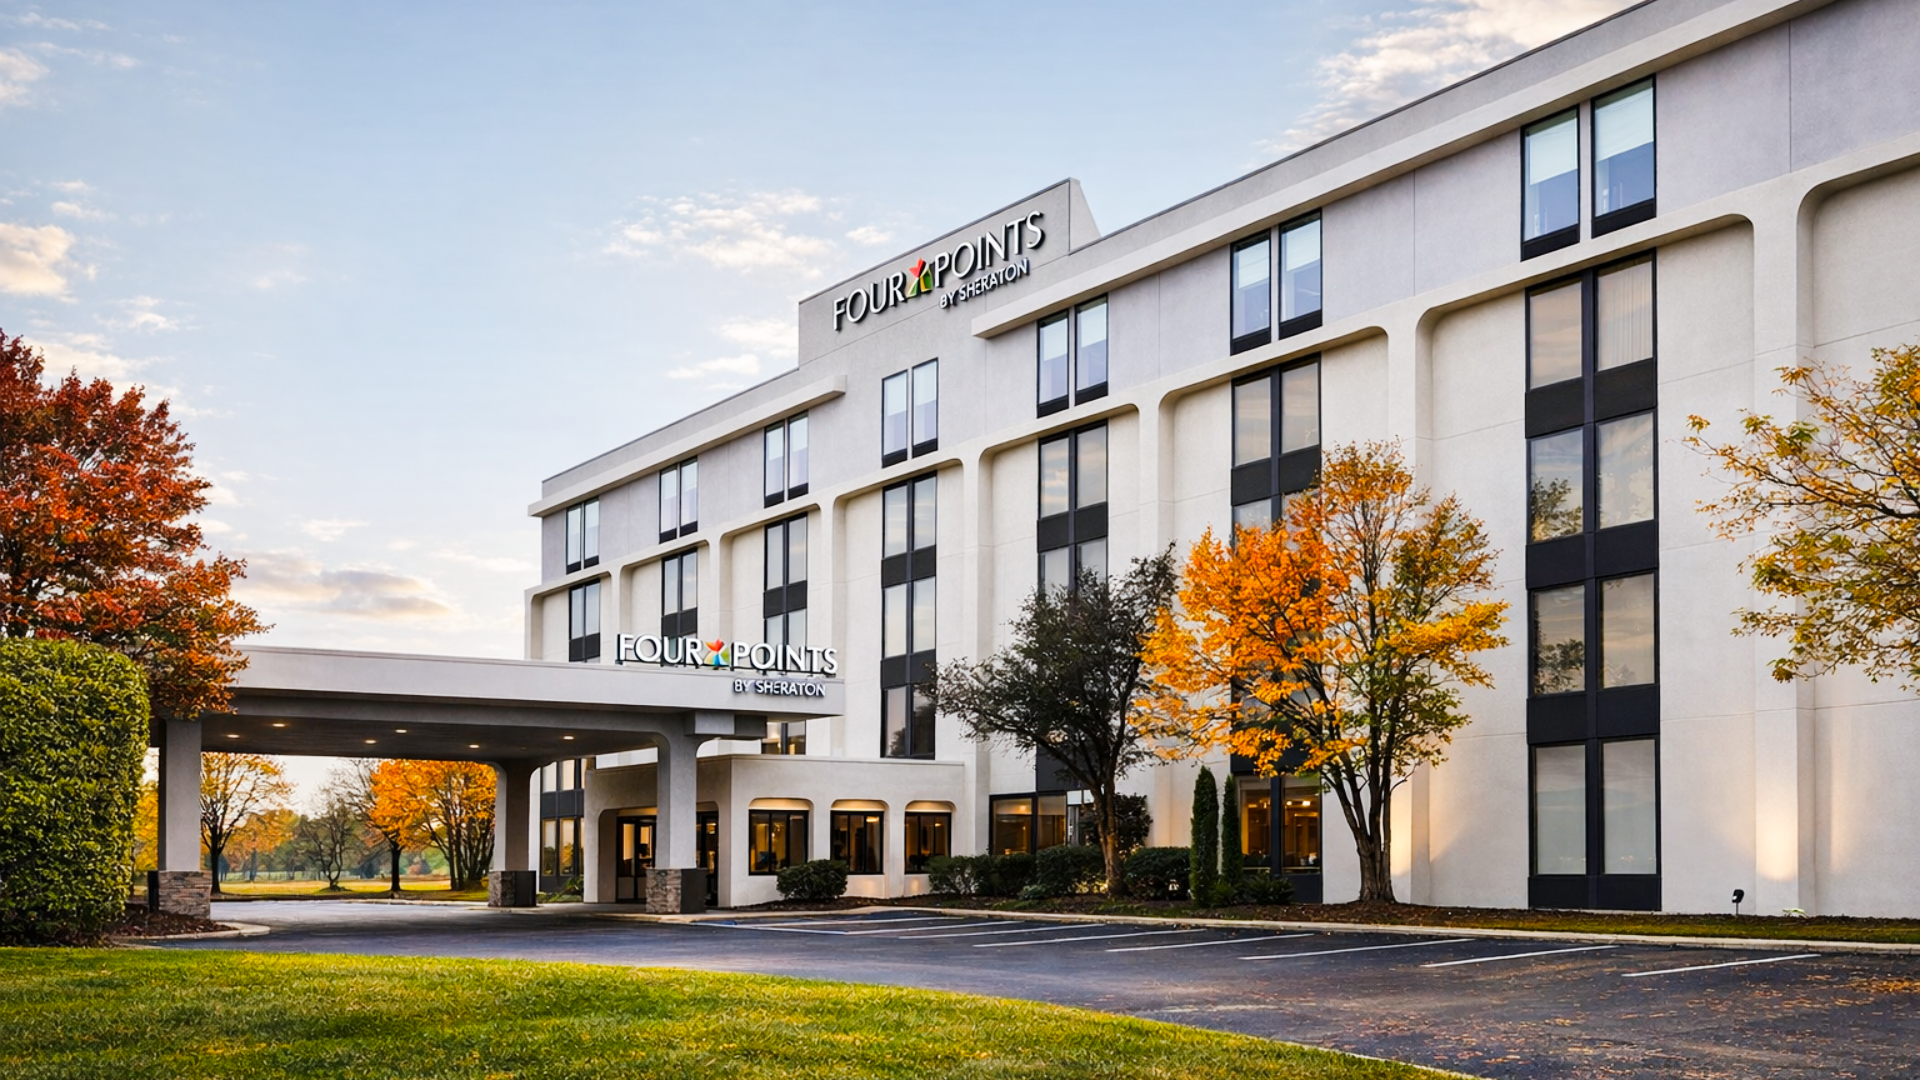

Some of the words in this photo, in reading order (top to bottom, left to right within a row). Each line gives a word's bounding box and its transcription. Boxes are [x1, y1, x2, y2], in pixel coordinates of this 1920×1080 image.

[833, 271, 906, 331] FOUR
[934, 210, 1044, 288] POINTS
[939, 291, 957, 309] BY
[959, 257, 1031, 301] SHERATON
[618, 633, 704, 666] FOUR
[732, 641, 839, 675] POINTS
[734, 679, 751, 692] BY
[755, 680, 827, 697] SHERATON
